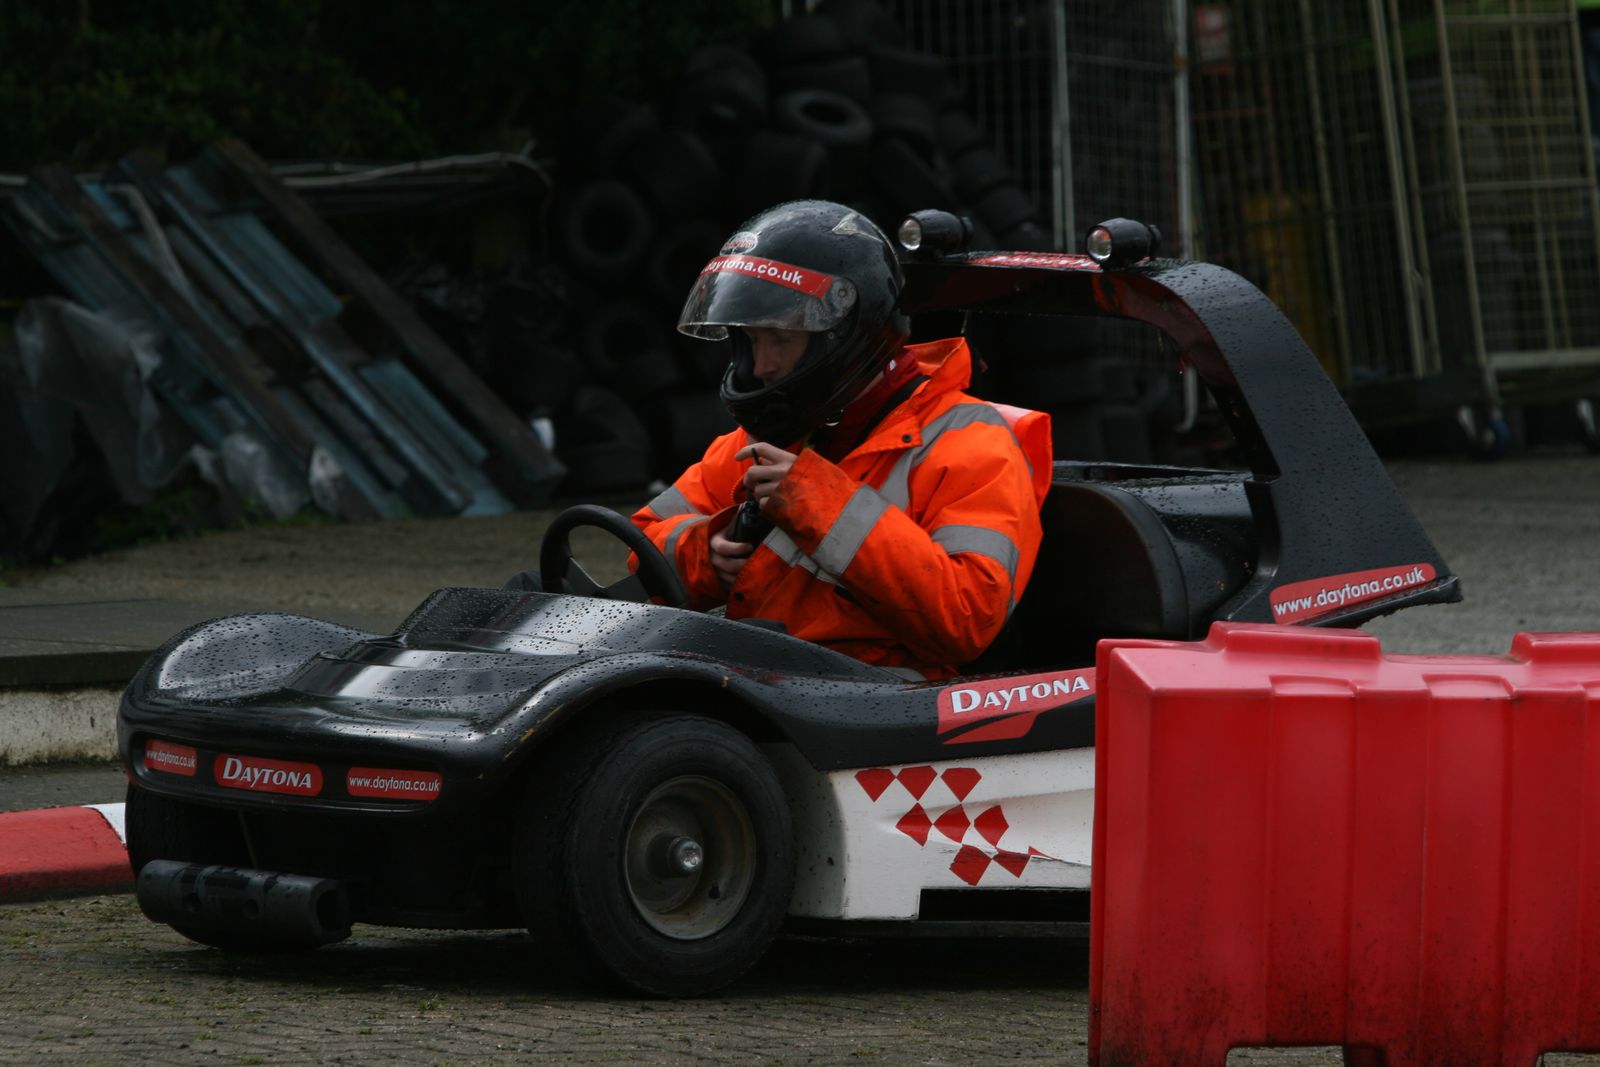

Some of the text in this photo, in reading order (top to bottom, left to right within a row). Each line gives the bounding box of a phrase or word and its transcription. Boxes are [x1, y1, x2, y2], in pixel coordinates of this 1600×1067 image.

[1274, 567, 1426, 616] www.daytona.co.uk
[951, 676, 1090, 713] DAYTONA
[222, 757, 312, 788] DAYTONA
[349, 775, 440, 793] www.daytona.co.uk
